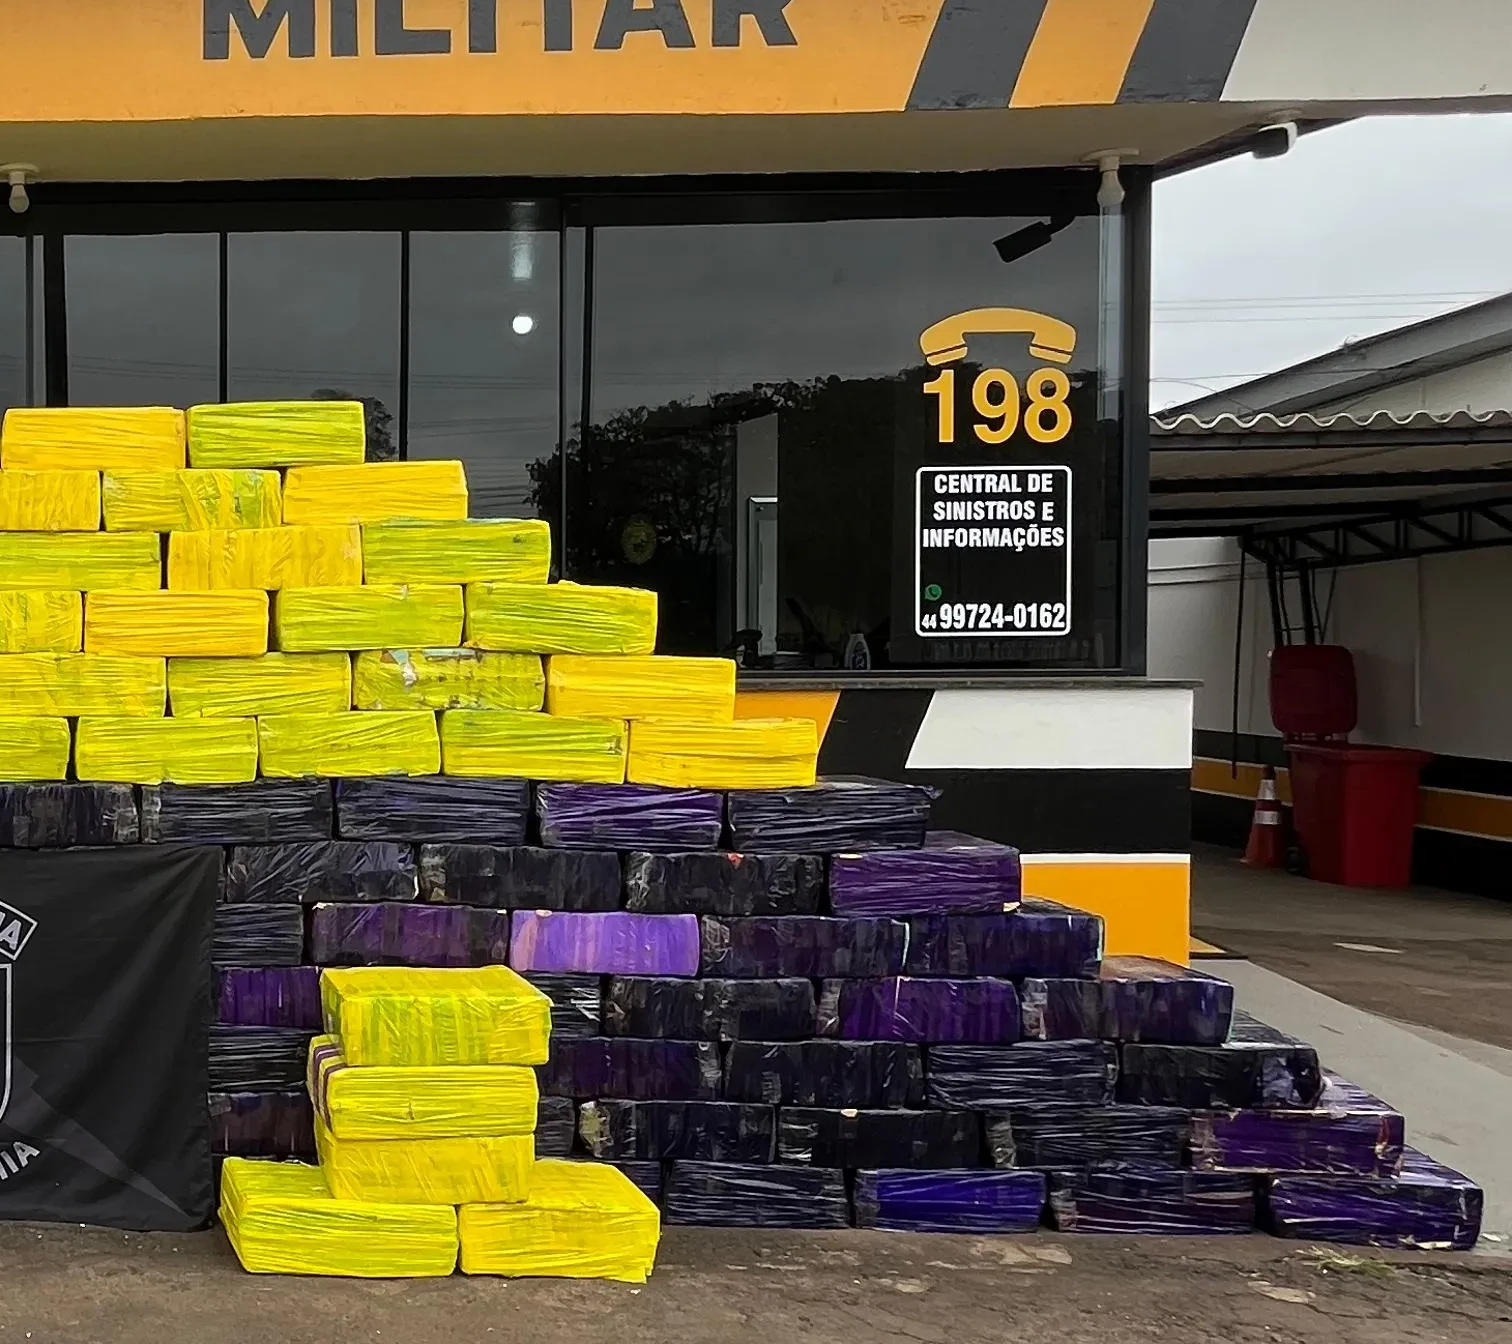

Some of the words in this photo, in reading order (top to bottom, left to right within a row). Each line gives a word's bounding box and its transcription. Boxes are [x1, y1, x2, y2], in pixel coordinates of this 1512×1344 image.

[923, 367, 1073, 445] 198
[934, 473, 1022, 494] CENTRAL
[1027, 473, 1053, 493] DE
[933, 500, 1035, 521] SINISTROS
[1041, 501, 1054, 521] E
[922, 523, 1065, 552] INFORMAÇÕES
[921, 613, 937, 629] 44
[939, 602, 1066, 629] 99724-0162
